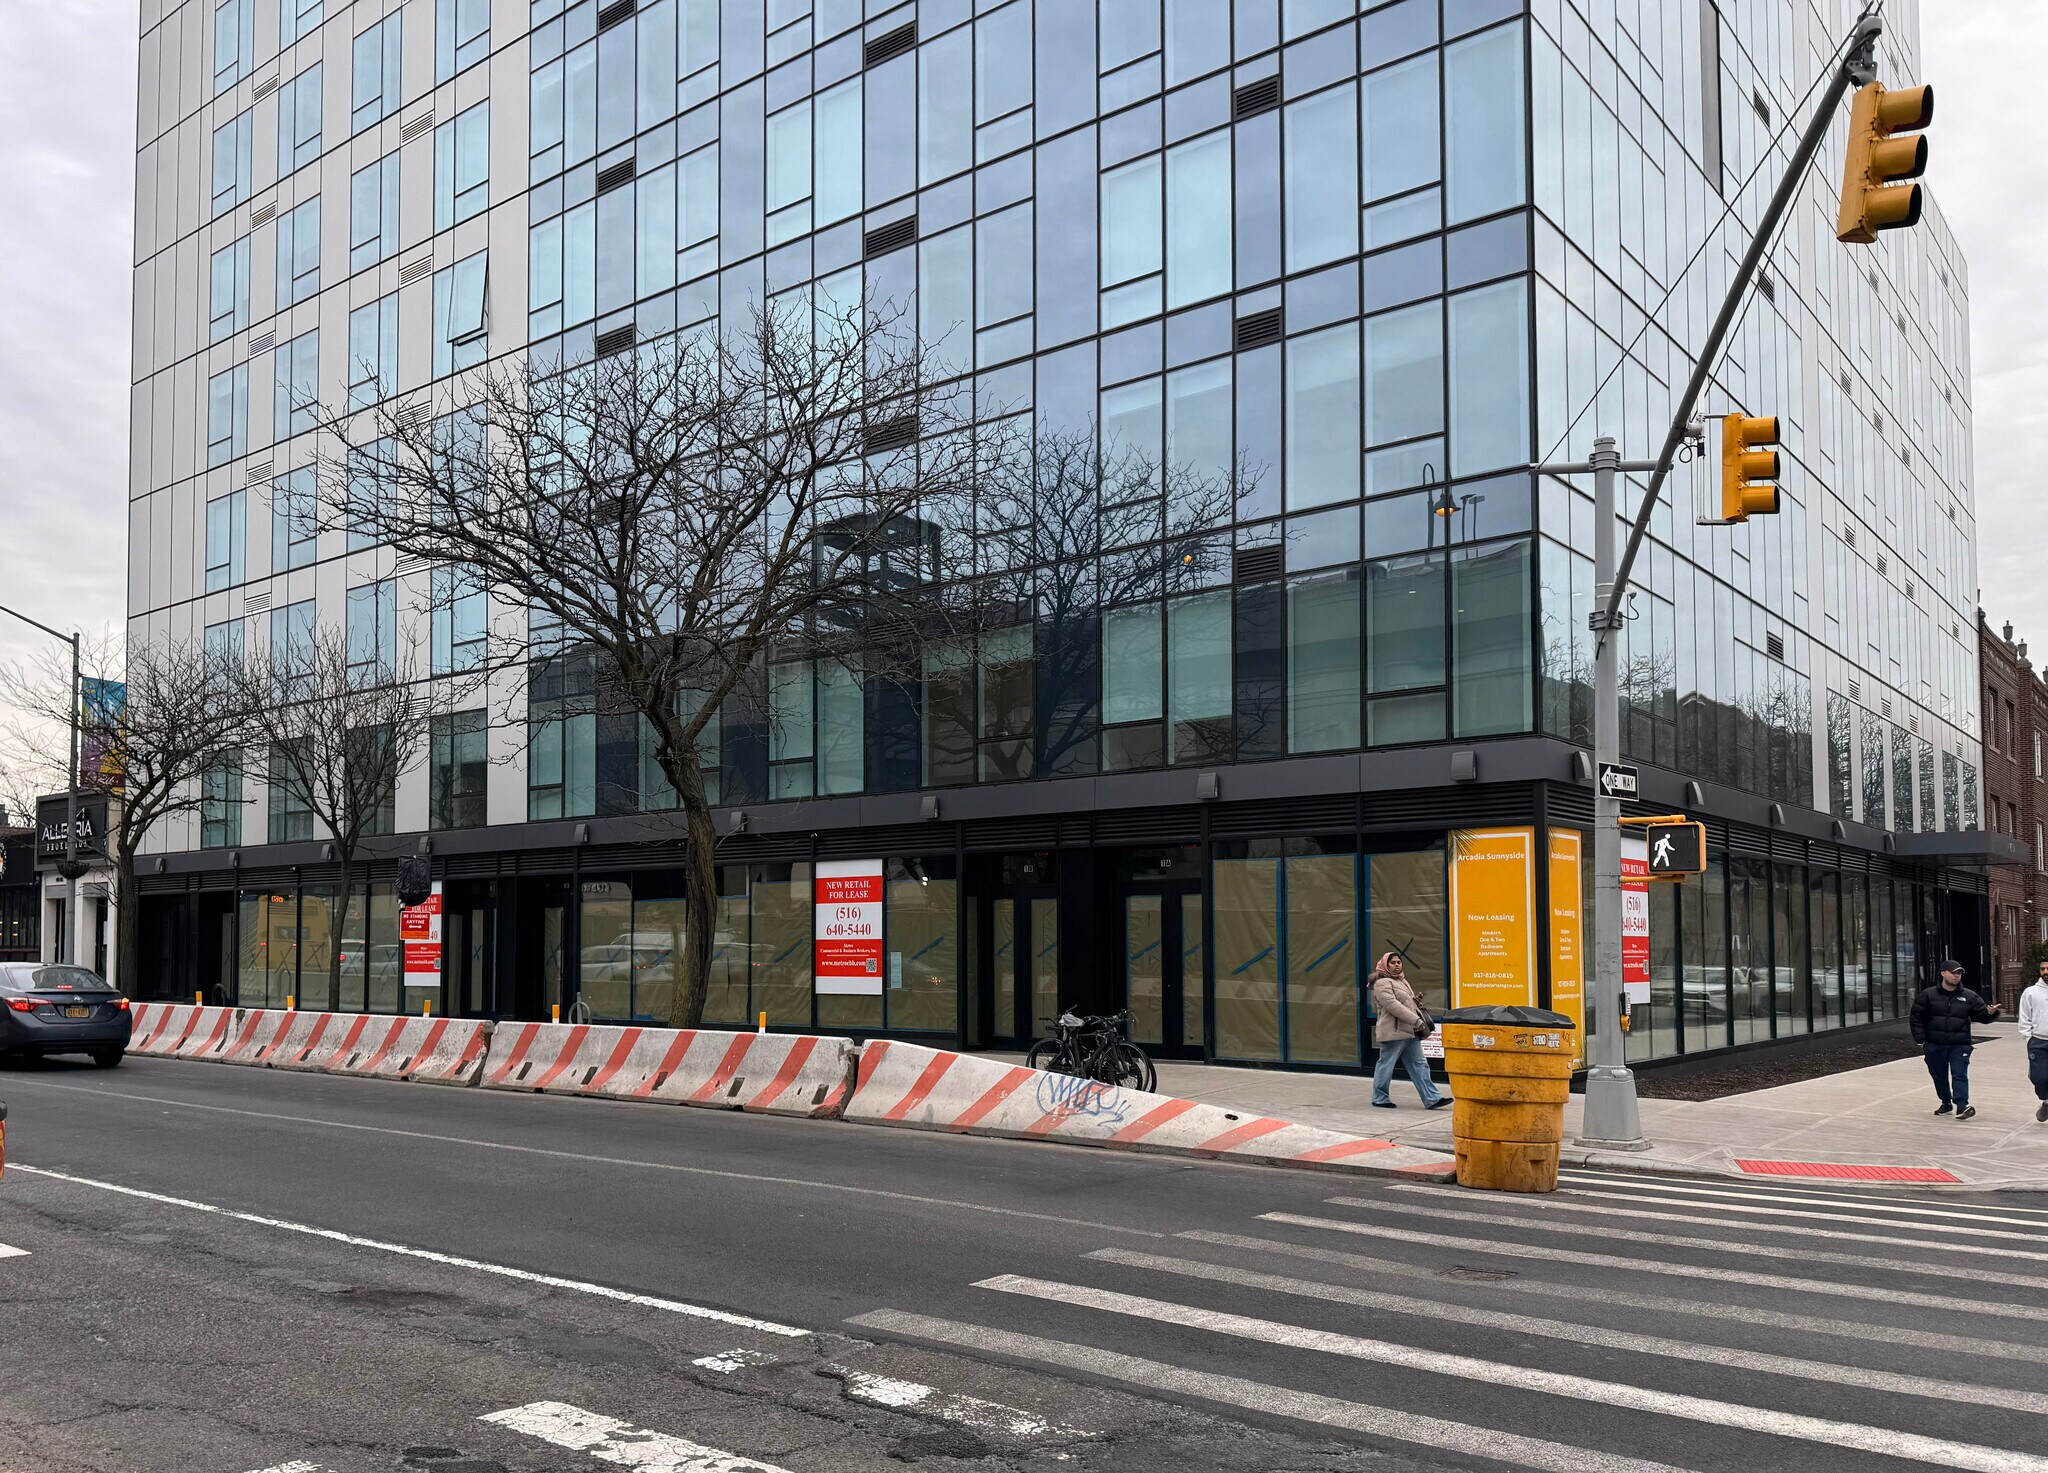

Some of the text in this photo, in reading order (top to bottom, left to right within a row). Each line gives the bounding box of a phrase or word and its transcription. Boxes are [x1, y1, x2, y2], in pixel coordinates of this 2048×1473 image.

[1606, 774, 1634, 789] ONE WAY
[42, 820, 92, 841] ALLERIA
[1458, 852, 1525, 861] Arcadia Sunnyside
[1631, 865, 1645, 875] RETAIL
[826, 880, 871, 890] NEW RETAIL
[829, 890, 869, 899] FOR LEASE
[1626, 896, 1641, 914] (516)
[835, 906, 862, 922] (516)
[1486, 913, 1515, 922] Leasing
[826, 923, 872, 936] 640-5440
[1622, 917, 1646, 932] 640-5440
